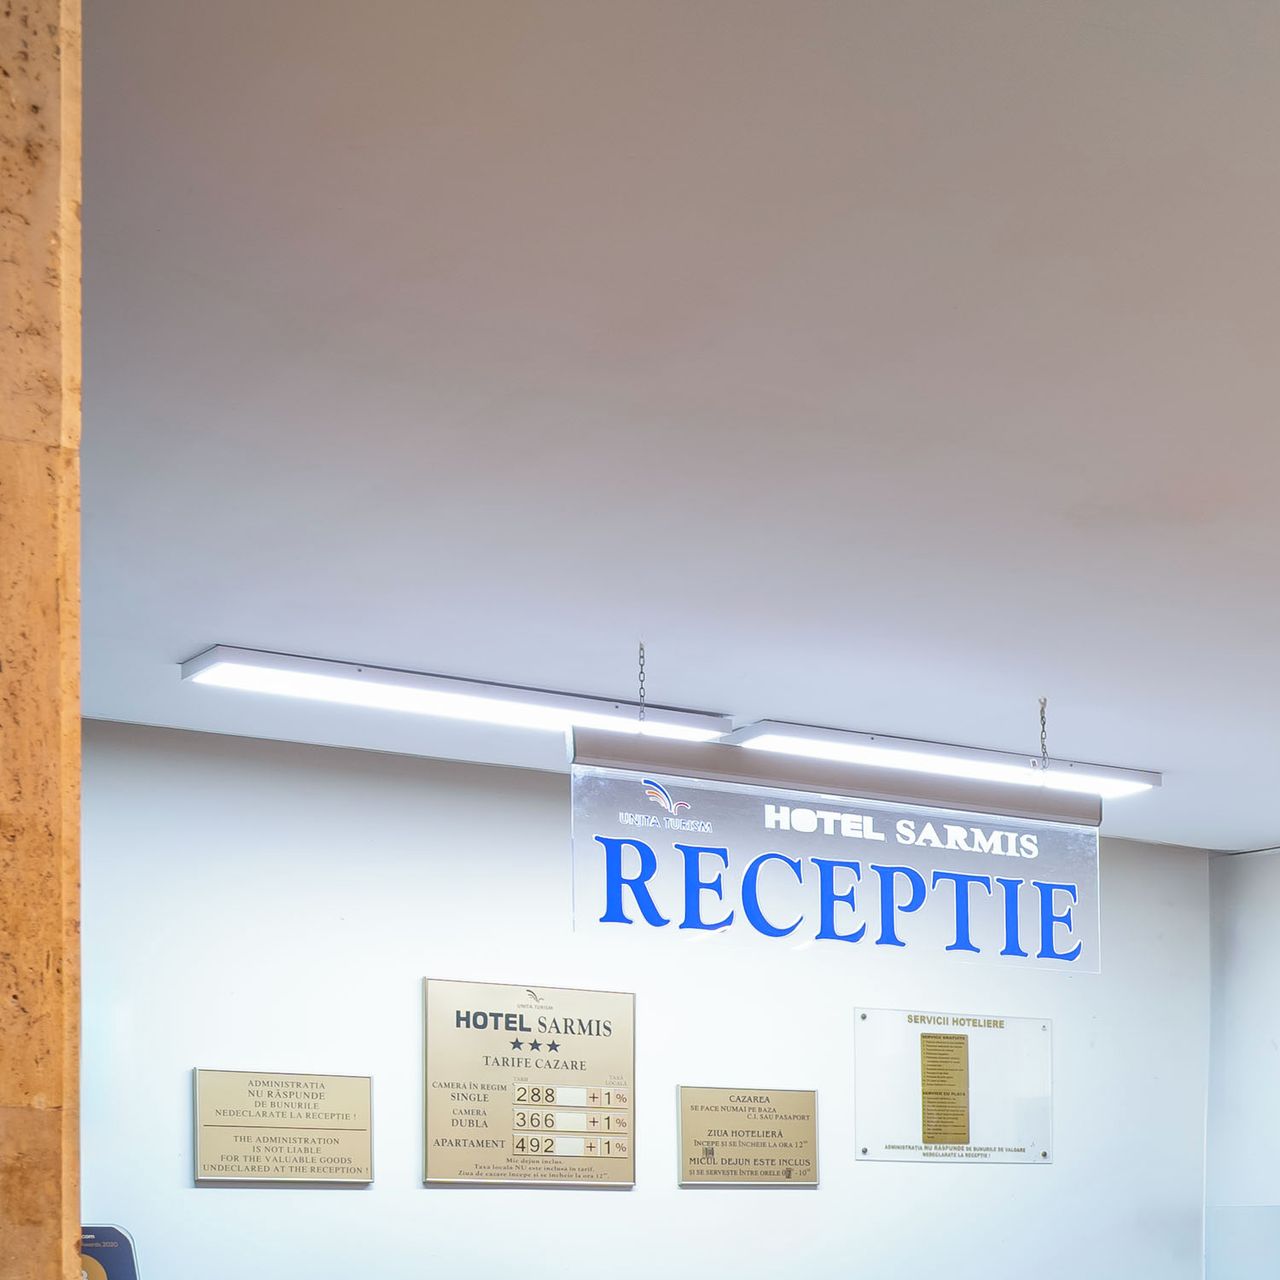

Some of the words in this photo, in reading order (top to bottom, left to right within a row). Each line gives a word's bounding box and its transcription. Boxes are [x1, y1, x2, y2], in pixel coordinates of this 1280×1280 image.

[663, 816, 713, 833] TURISM
[764, 804, 884, 842] HOTEL
[896, 818, 1040, 859] SARMIS
[593, 834, 1083, 963] RECEPTIE
[456, 1010, 532, 1033] HOTEL
[538, 1016, 613, 1037] SARMIS
[907, 1014, 949, 1026] SERVICII
[952, 1017, 1005, 1029] HOTELIERE
[483, 1055, 531, 1068] TARIFE
[535, 1058, 587, 1071] CAZARE
[481, 1083, 507, 1092] REGIM
[248, 1090, 263, 1098] NU
[450, 1092, 489, 1103] SINGLE
[516, 1087, 555, 1103] 288
[729, 1095, 770, 1104] CAZAREA
[254, 1100, 268, 1108] DE
[270, 1101, 319, 1110] BUNURILE
[215, 1109, 287, 1119] NEDECLARATE
[290, 1111, 302, 1119] LA
[516, 1112, 555, 1128] 366
[707, 1129, 729, 1138] ZIUA
[233, 1135, 252, 1143] THE
[255, 1136, 340, 1145] ADMINISTRATION
[433, 1139, 506, 1149] APARTAMENT
[252, 1145, 261, 1153] IS
[264, 1146, 283, 1154] NOT
[515, 1138, 554, 1153] 492
[220, 1154, 239, 1162] FOR
[243, 1155, 262, 1163] THE
[265, 1155, 317, 1164] VALUABLE
[689, 1157, 718, 1166] MICUL
[721, 1158, 751, 1166] DEJUN
[753, 1158, 777, 1167] ESTE
[779, 1158, 811, 1167] INCLUS
[203, 1164, 271, 1173] UNDECLARED
[273, 1165, 286, 1173] AT
[288, 1165, 307, 1173] THE
[309, 1166, 363, 1174] RECEPTION
